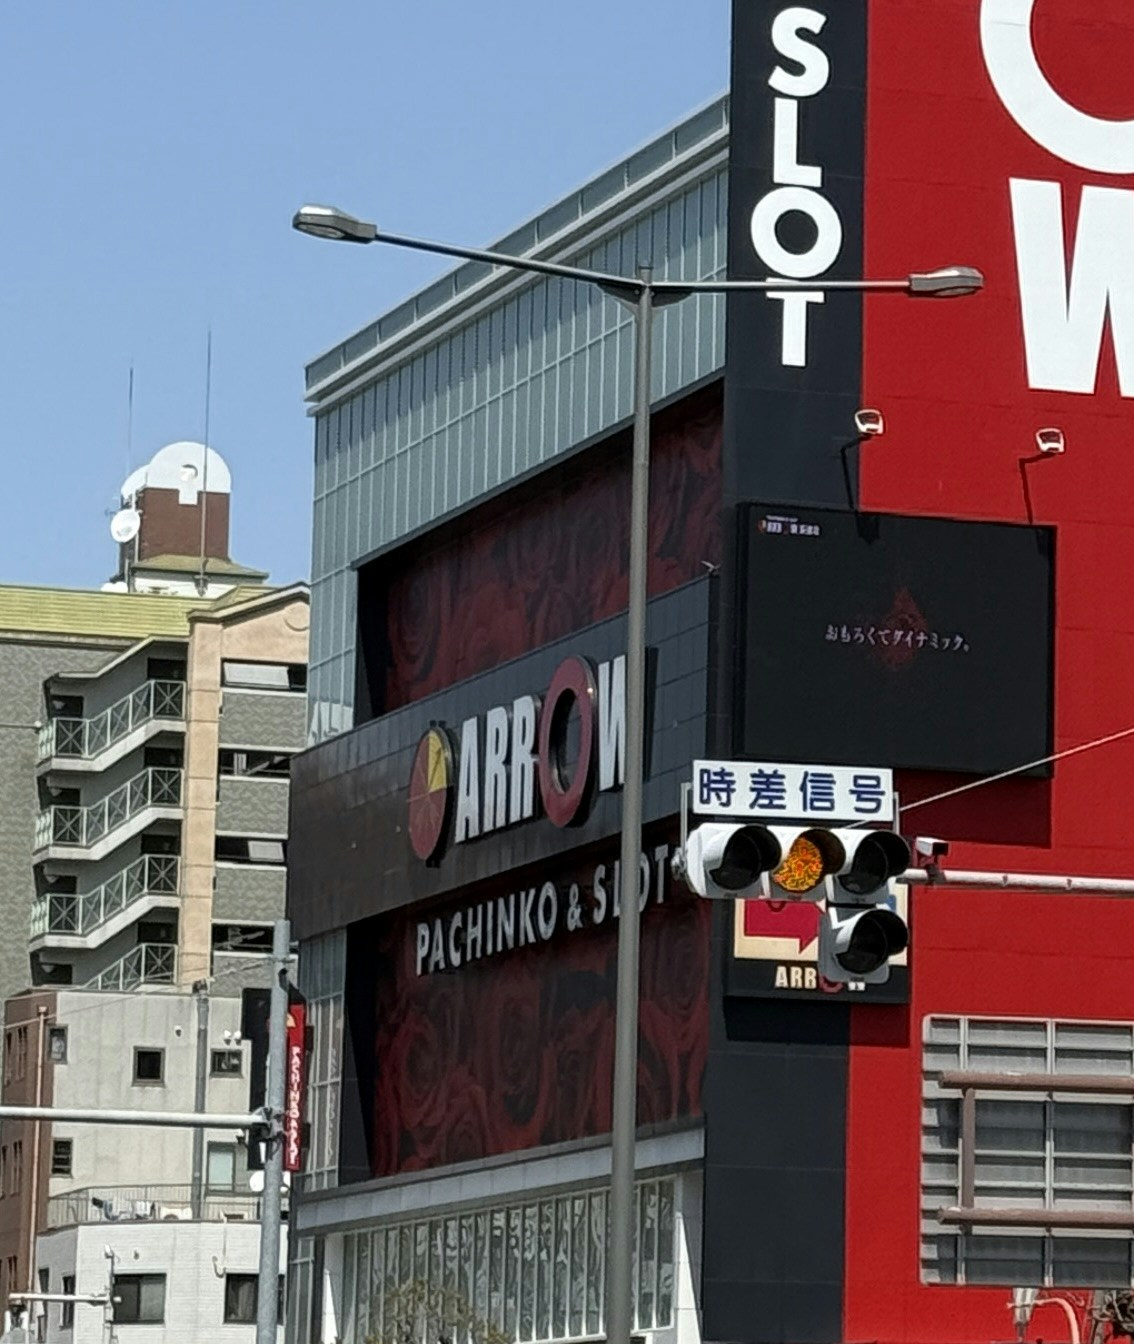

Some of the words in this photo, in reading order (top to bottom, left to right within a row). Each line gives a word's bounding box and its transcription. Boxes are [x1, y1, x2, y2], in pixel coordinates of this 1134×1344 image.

[750, 6, 843, 367] SLOT
[699, 767, 886, 814] 時差信号
[416, 880, 557, 977] PACHINKO
[567, 882, 584, 932] &
[774, 965, 867, 994] ARR
